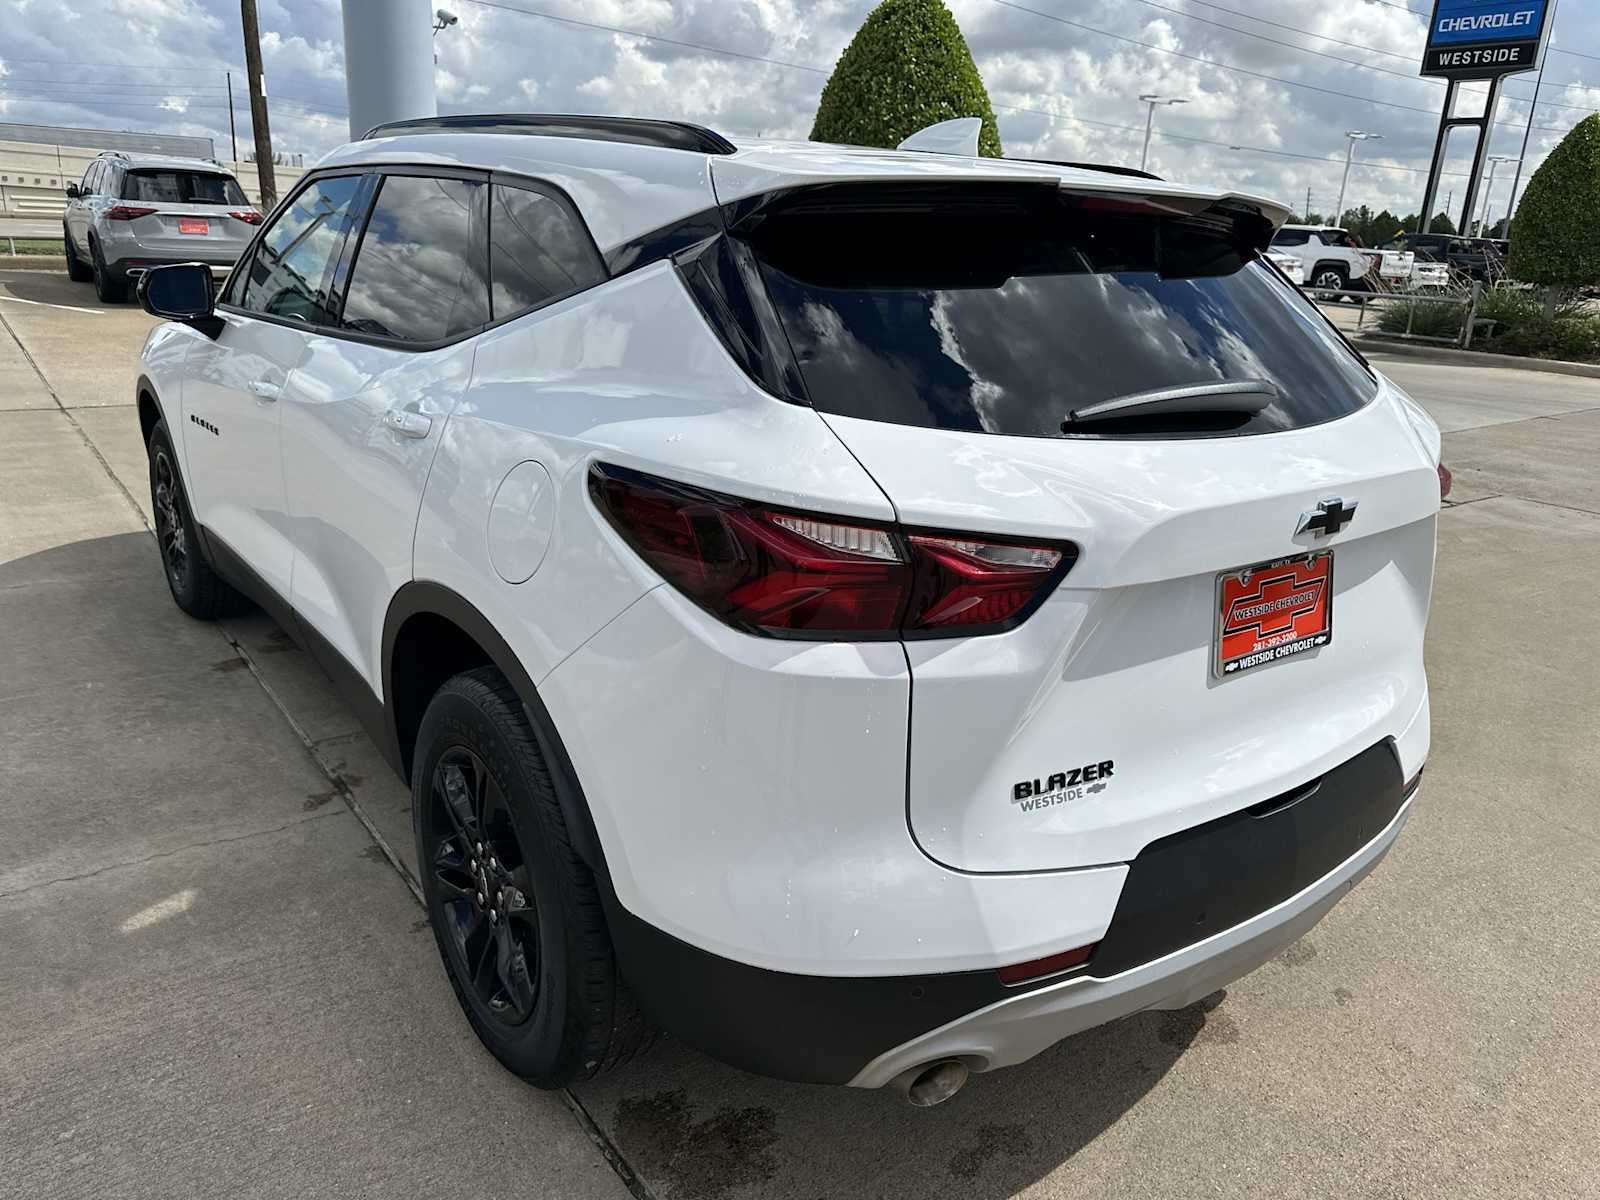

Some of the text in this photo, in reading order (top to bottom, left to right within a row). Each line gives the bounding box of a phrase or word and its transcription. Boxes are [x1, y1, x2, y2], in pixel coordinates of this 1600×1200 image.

[1438, 10, 1535, 33] CHEVROLET
[1439, 48, 1520, 66] WESTSIDE
[1233, 589, 1316, 621] WESTSIDE CHEVROLET
[1239, 638, 1315, 669] WESTSIDE CHEVROLET
[1011, 760, 1114, 803] BLAZER
[1020, 787, 1083, 812] WESTSIDE
